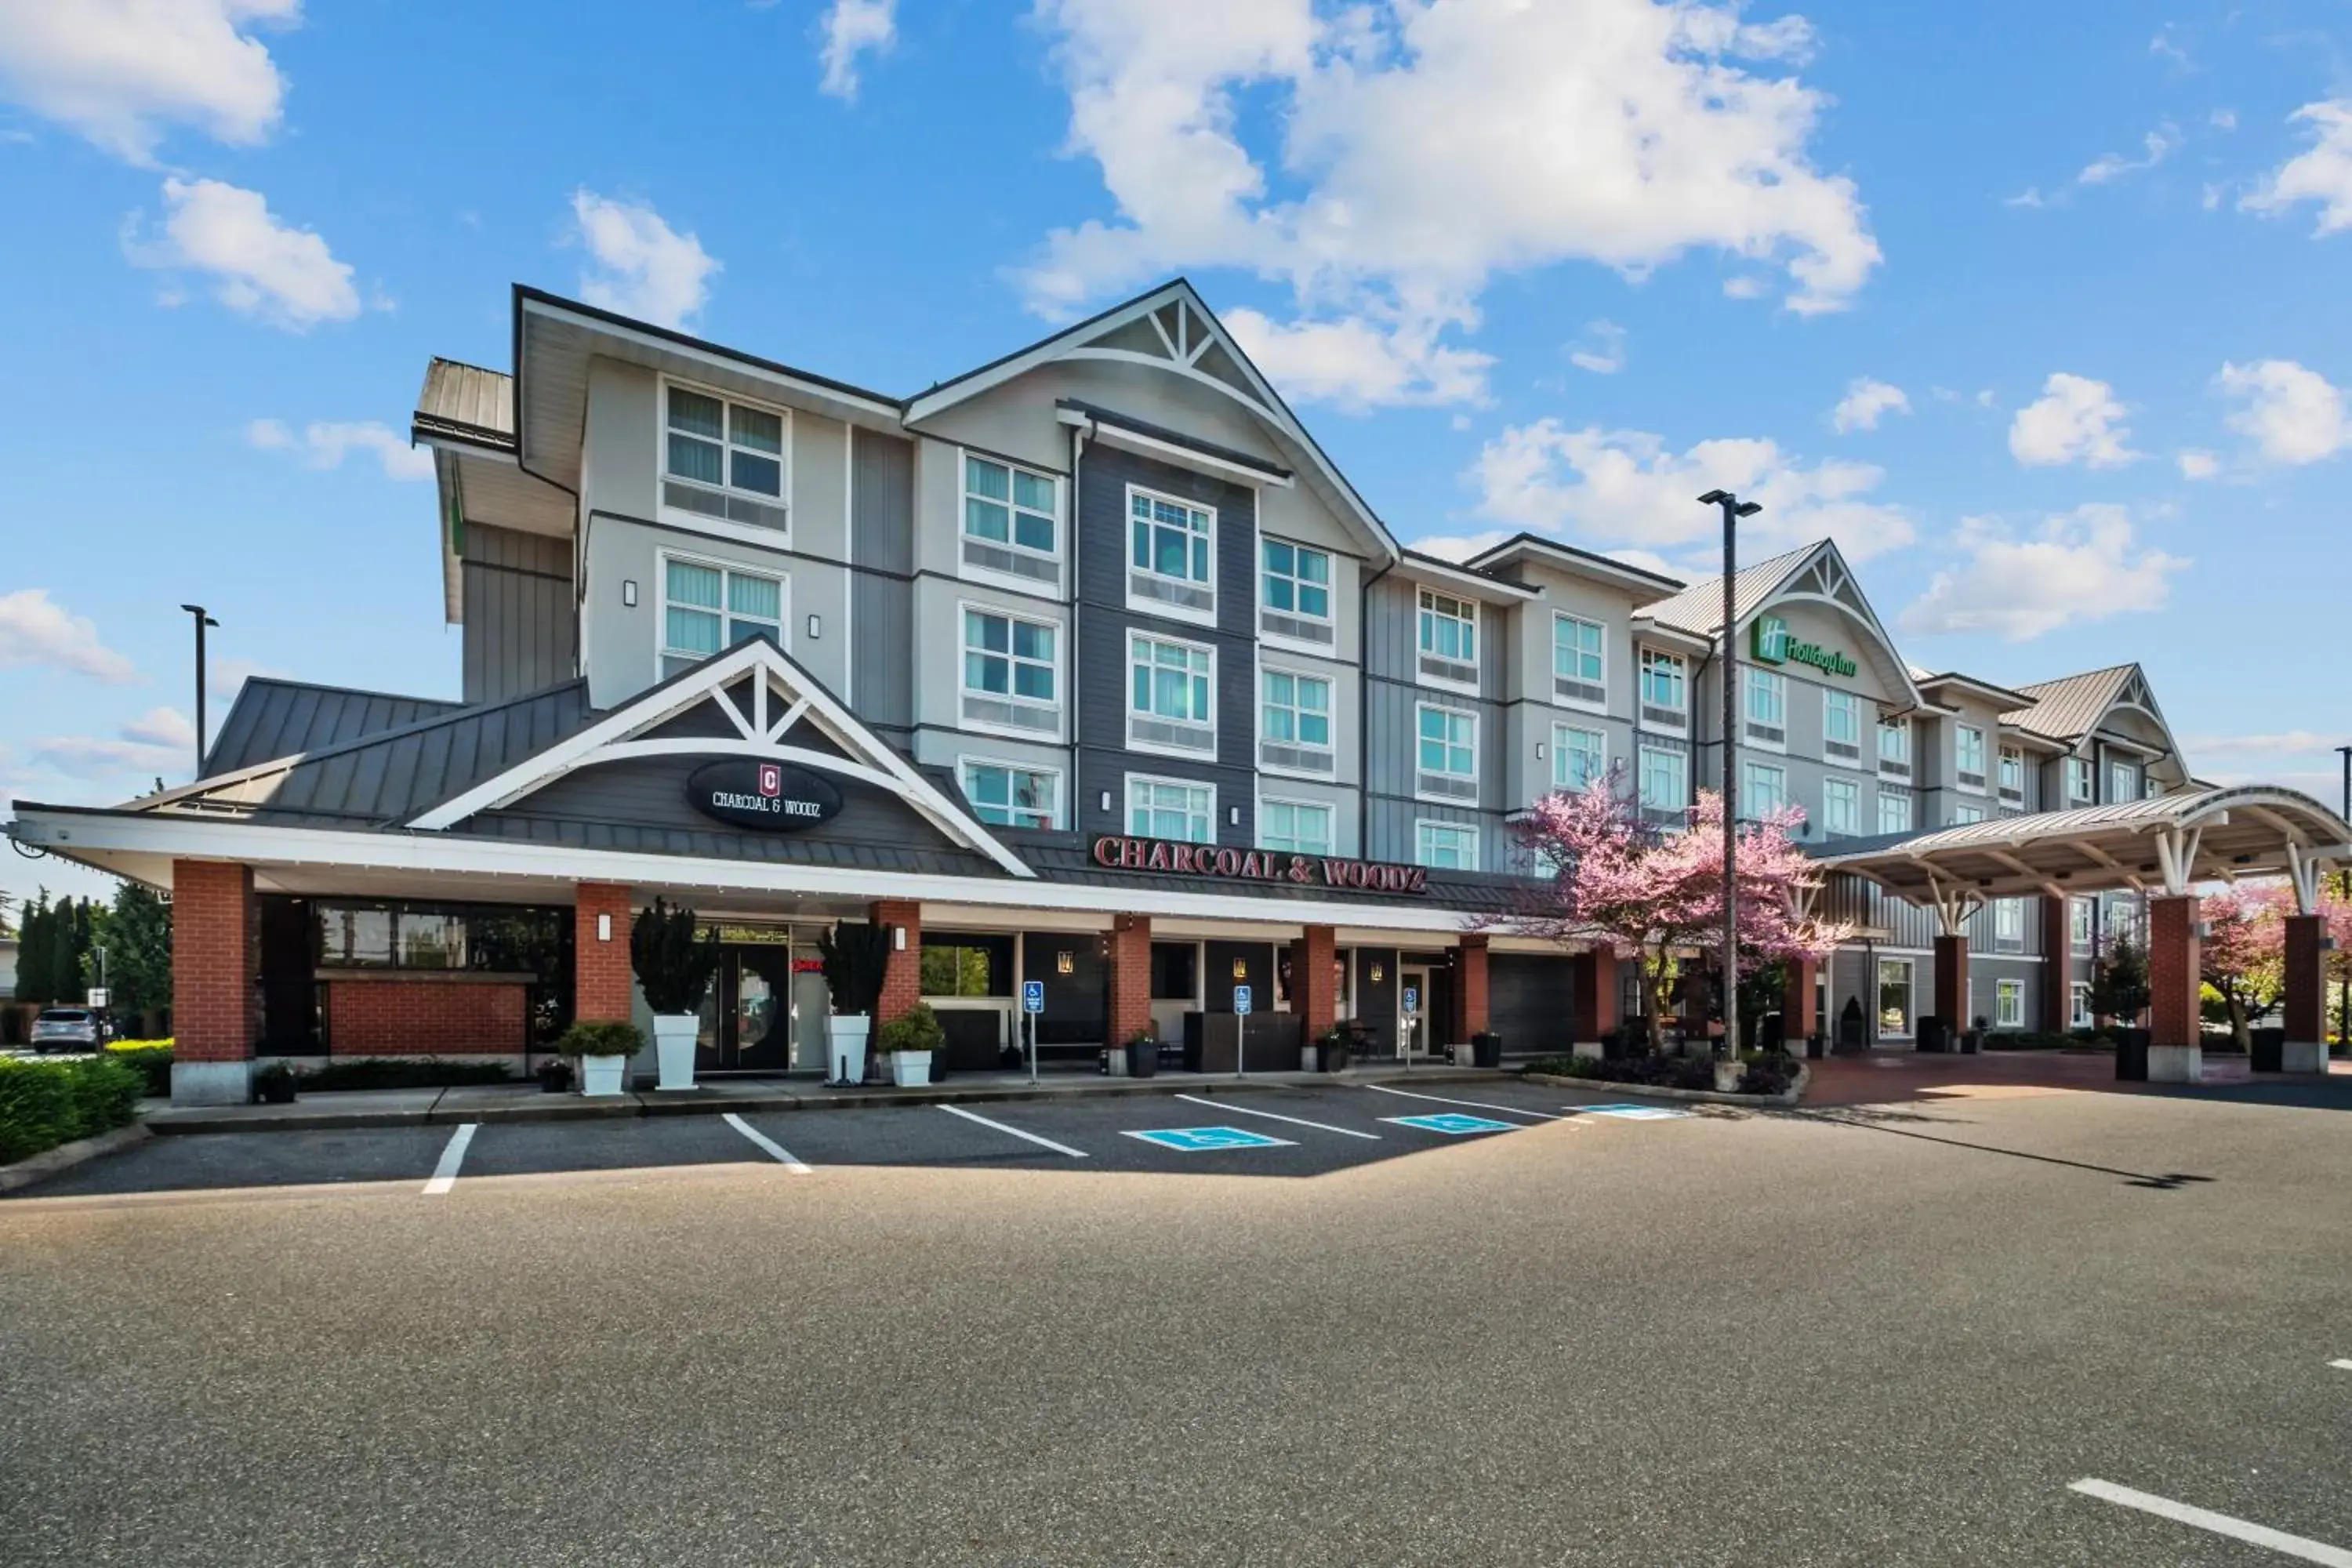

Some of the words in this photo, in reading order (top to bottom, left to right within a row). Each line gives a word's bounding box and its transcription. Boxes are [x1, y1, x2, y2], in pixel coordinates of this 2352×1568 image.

[1787, 637, 1835, 676] Holiday
[1834, 652, 1857, 677] Inn
[764, 771, 776, 789] C
[712, 791, 768, 812] CHARCOAL
[771, 799, 781, 813] &
[785, 799, 821, 818] WOODZ
[1094, 836, 1283, 880] CHARCOAL
[1288, 855, 1314, 883] &
[1320, 858, 1427, 892] WOODZ
